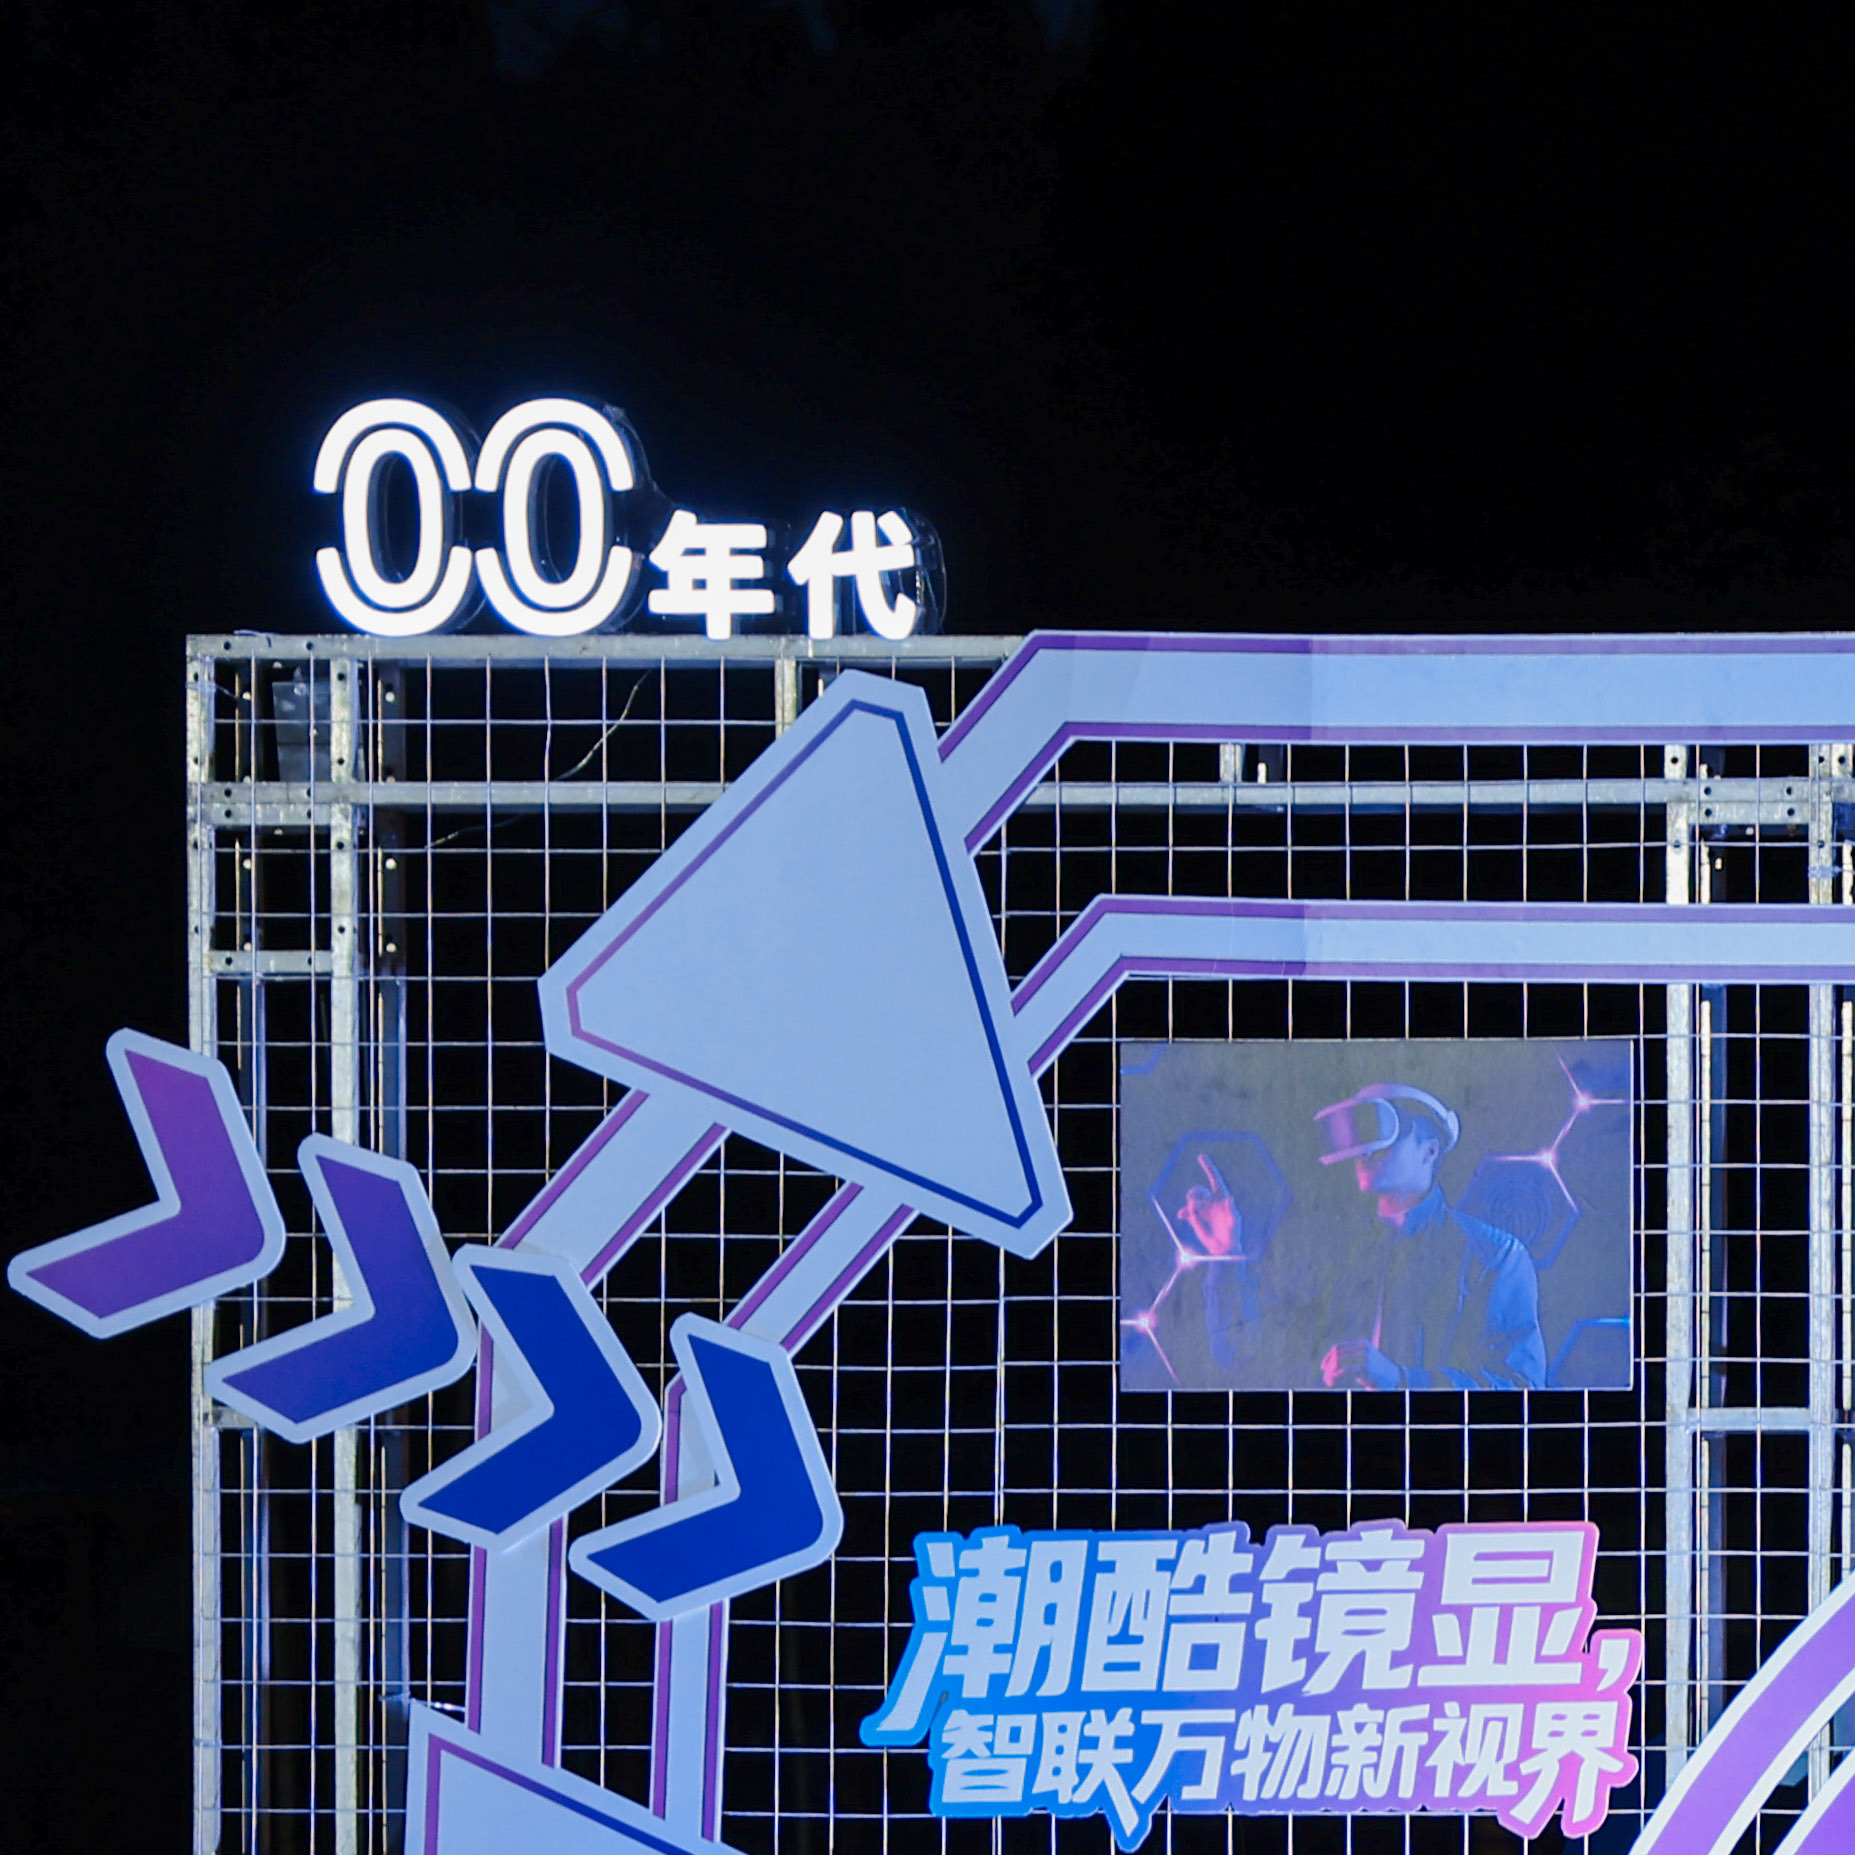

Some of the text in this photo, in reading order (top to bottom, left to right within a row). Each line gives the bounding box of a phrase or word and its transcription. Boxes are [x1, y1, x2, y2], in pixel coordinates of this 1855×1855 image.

[312, 397, 919, 640] 00年代
[940, 1704, 1626, 1838] 智联万物新视界
